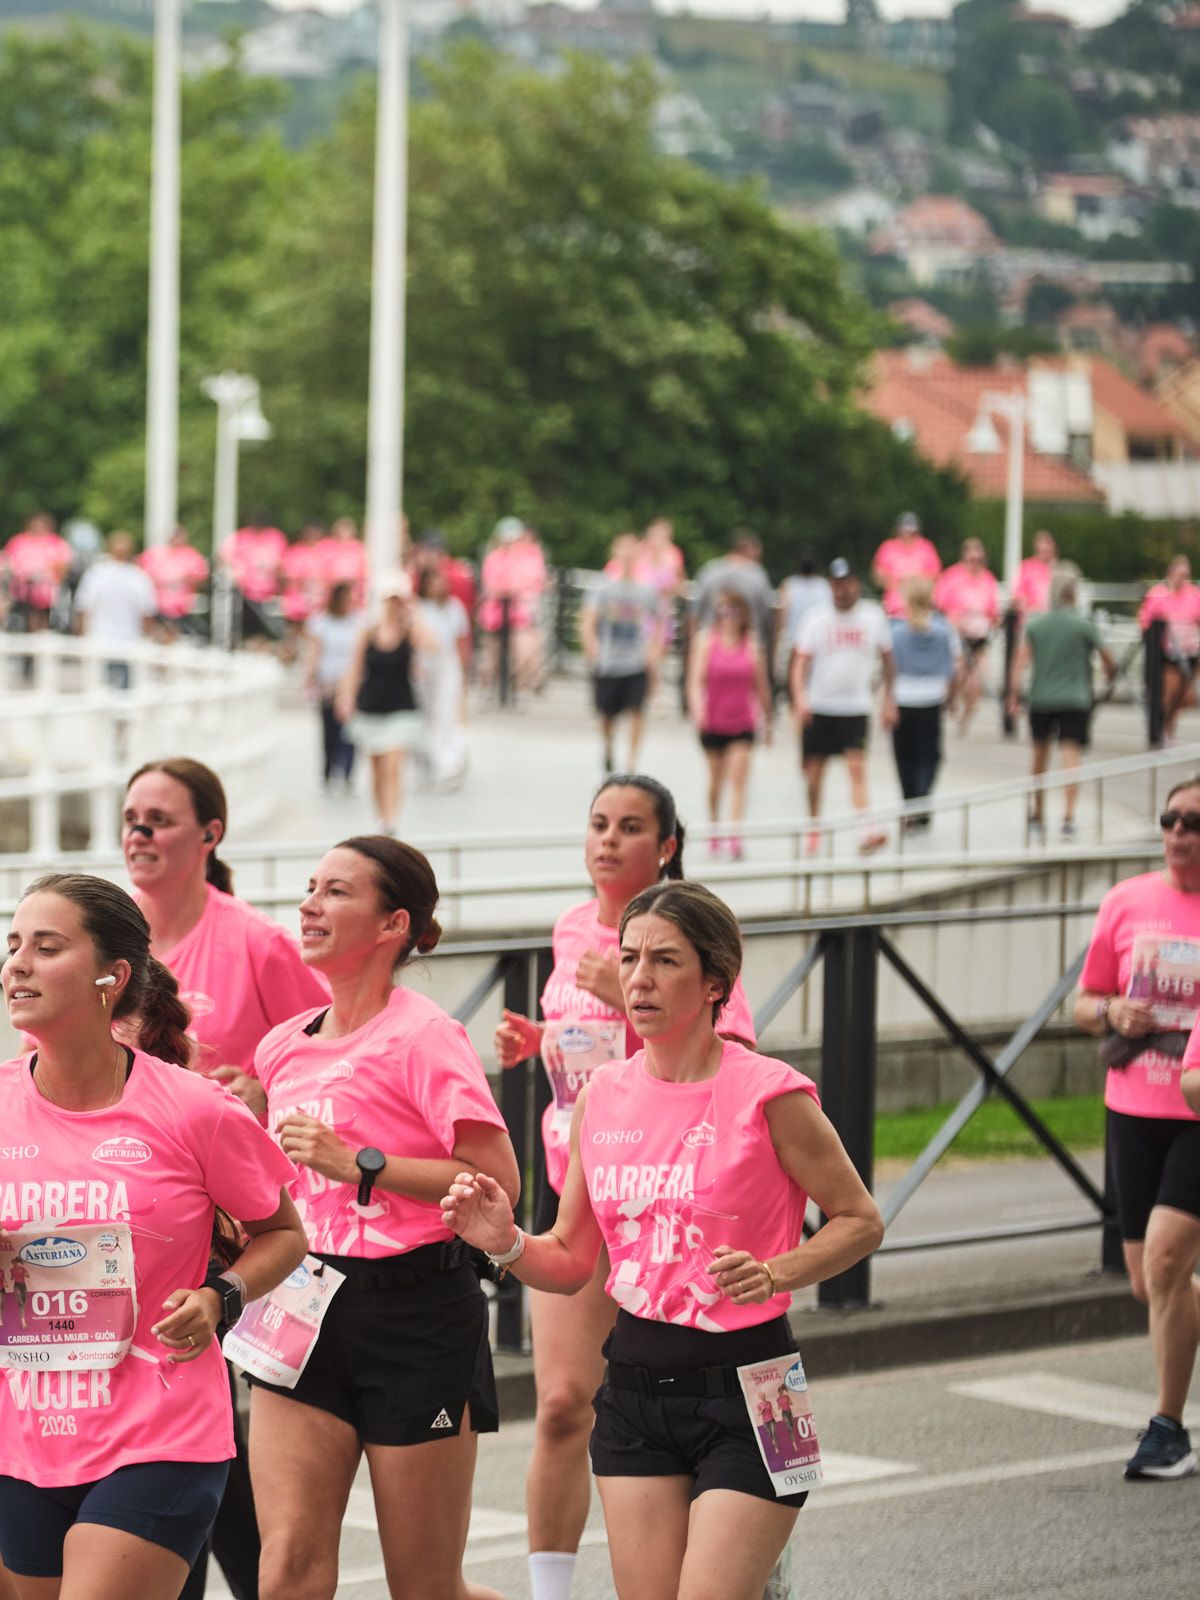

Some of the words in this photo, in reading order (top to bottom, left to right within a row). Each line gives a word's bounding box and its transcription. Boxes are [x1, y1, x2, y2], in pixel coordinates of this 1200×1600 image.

[566, 1072, 589, 1092] 01
[593, 1130, 643, 1145] OYSHO
[96, 1148, 148, 1159] ASTURIANA
[593, 1163, 695, 1203] CARRERA
[650, 1214, 683, 1264] DE
[25, 1248, 83, 1261] ASTURIANA
[31, 1290, 89, 1316] 016
[90, 1290, 130, 1298] CORREDORA
[48, 1320, 75, 1331] 1440
[262, 1304, 286, 1330] 016
[7, 1334, 40, 1344] CARRERA
[41, 1333, 52, 1343] DE
[53, 1332, 63, 1342] LA
[64, 1331, 89, 1341] MUJER
[8, 1350, 50, 1363] OYSHO
[79, 1350, 122, 1361] Santander
[754, 1372, 781, 1386] SUMA
[38, 1414, 78, 1437] 2026
[798, 1414, 817, 1439] 01
[784, 1470, 817, 1487] OYSHO
